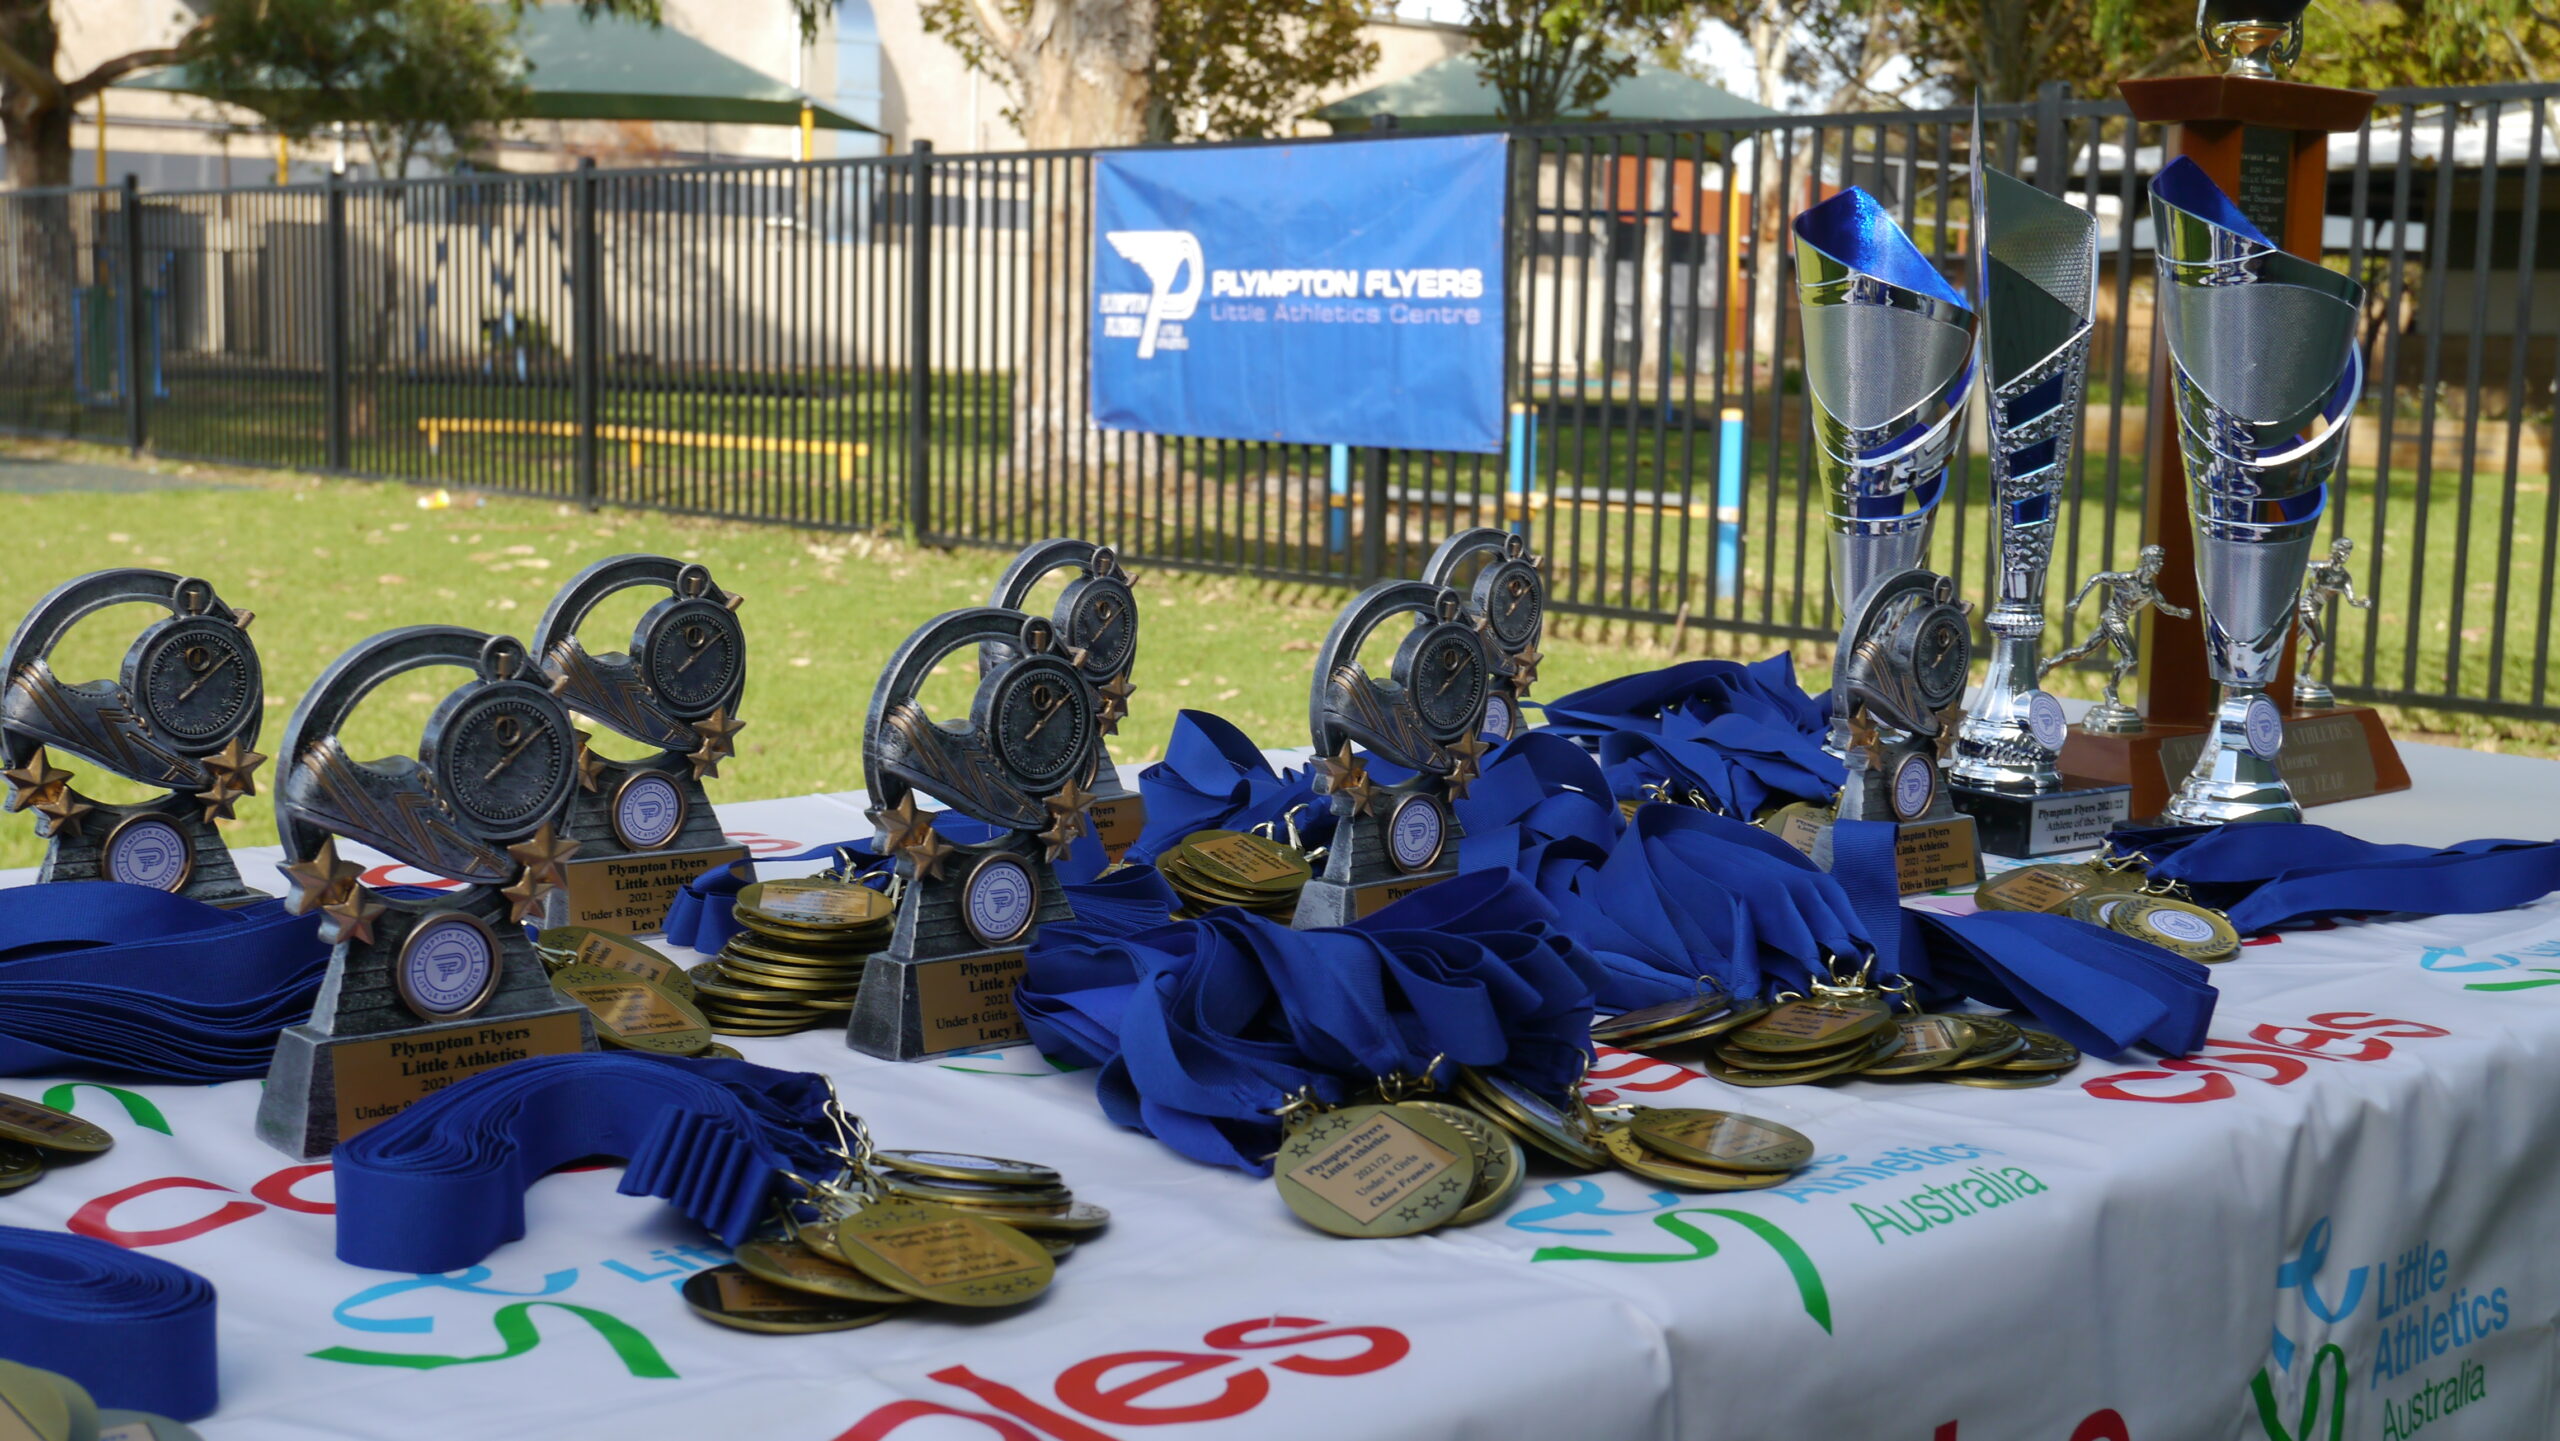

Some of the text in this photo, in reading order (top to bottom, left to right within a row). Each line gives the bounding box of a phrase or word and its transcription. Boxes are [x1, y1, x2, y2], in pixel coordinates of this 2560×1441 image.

[1211, 268, 1484, 299] PLYMPTON FLYERS
[1210, 303, 1481, 325] Little Athletics Centre
[626, 785, 673, 811] PLYMPTON FLYERS
[2038, 805, 2073, 820] Plympton
[2074, 803, 2096, 816] Flyers
[626, 813, 673, 838] LITTLE ATHLETICS
[1898, 828, 1950, 844] ympton Flyers
[2046, 818, 2073, 832] Athlete
[2074, 818, 2083, 828] of
[2083, 817, 2096, 828] the
[120, 830, 177, 858] PLYMPTON FLYERS
[1897, 841, 1949, 856] Little Athletics
[2053, 833, 2071, 845] Amy
[608, 858, 708, 877] Plympton Flyers
[615, 874, 698, 890] Little Athleti
[976, 869, 1025, 898] PLYMPTON FLYERS
[1900, 880, 1922, 891] Olivia
[629, 893, 653, 904] 2021
[581, 910, 613, 921] Under
[616, 908, 622, 917] 8
[625, 906, 651, 917] Boys
[976, 902, 1026, 930] LITTLE ATHLETICS
[632, 919, 656, 932] Leo
[416, 931, 481, 967] PLYMPTON FLYERS
[960, 957, 1023, 976] Plympton
[416, 967, 482, 1000] LITTLE ATHLETICS
[969, 978, 1004, 993] Little
[984, 995, 1009, 1007] 2021
[936, 1015, 968, 1030] Under
[972, 1013, 979, 1024] 8
[982, 1010, 1008, 1023] Girls
[390, 1027, 531, 1058] Plympton Flyers
[978, 1024, 1012, 1041] Lucy
[401, 1047, 527, 1077] Little Athletics
[420, 1077, 454, 1093] 2021
[355, 1103, 399, 1121] Under
[1304, 1122, 1384, 1176] Plympton Flyers
[1320, 1132, 1392, 1180] Little Athletics
[1355, 1153, 1394, 1181] 2021/22
[1355, 1173, 1387, 1198] Under
[1393, 1153, 1420, 1173] Girls
[1369, 1161, 1436, 1208] Chloe Francis
[1849, 1166, 2049, 1245] Australia
[2376, 1240, 2449, 1322] Little
[2370, 1286, 2511, 1392] Athletics
[2382, 1357, 2487, 1441] Australia
